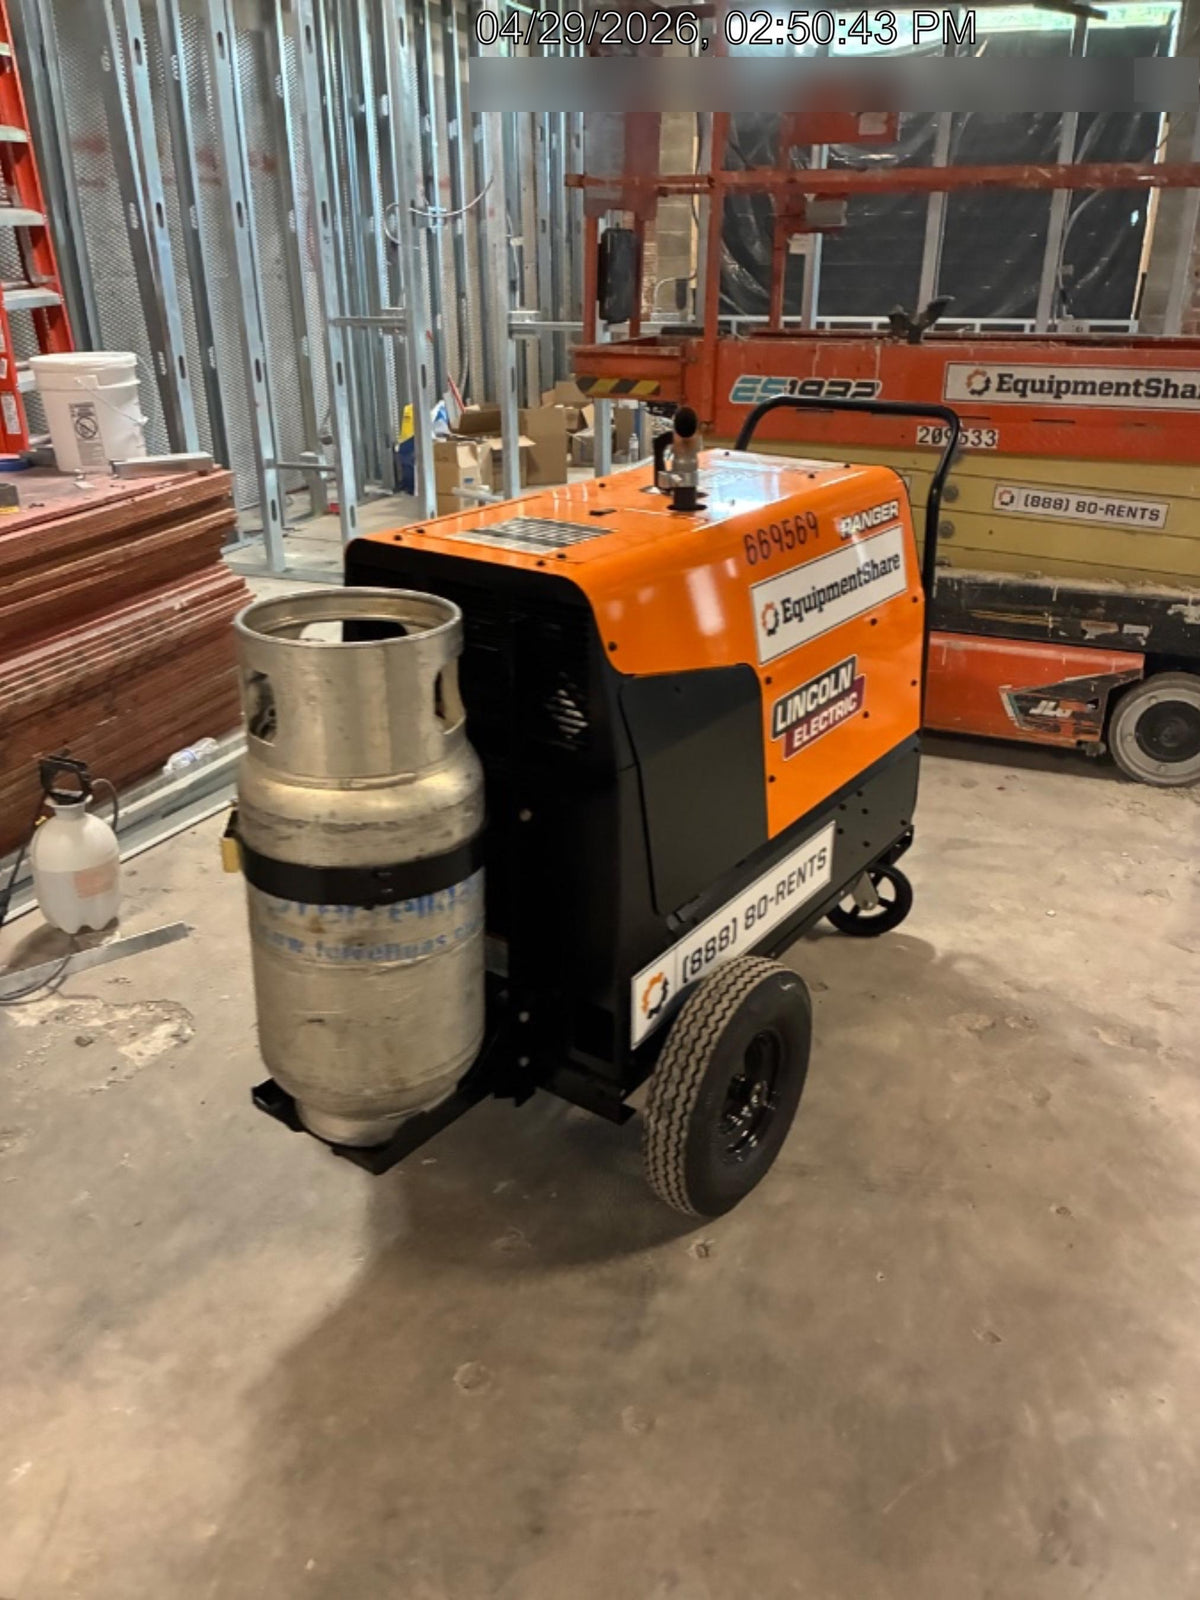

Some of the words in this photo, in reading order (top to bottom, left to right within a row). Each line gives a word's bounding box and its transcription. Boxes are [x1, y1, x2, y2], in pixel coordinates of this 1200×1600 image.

[996, 373, 1200, 399] EquipmentSha
[839, 501, 899, 540] RANGER
[1023, 493, 1070, 512] (888)
[1075, 500, 1160, 522] 80-RENTS
[743, 511, 820, 566] 669569
[780, 553, 900, 624] EquipmentShare
[775, 662, 853, 732] LINCOLN
[793, 692, 858, 749] ELECTRIC
[682, 916, 737, 984] (888)
[744, 846, 827, 931] 80-RENTS
